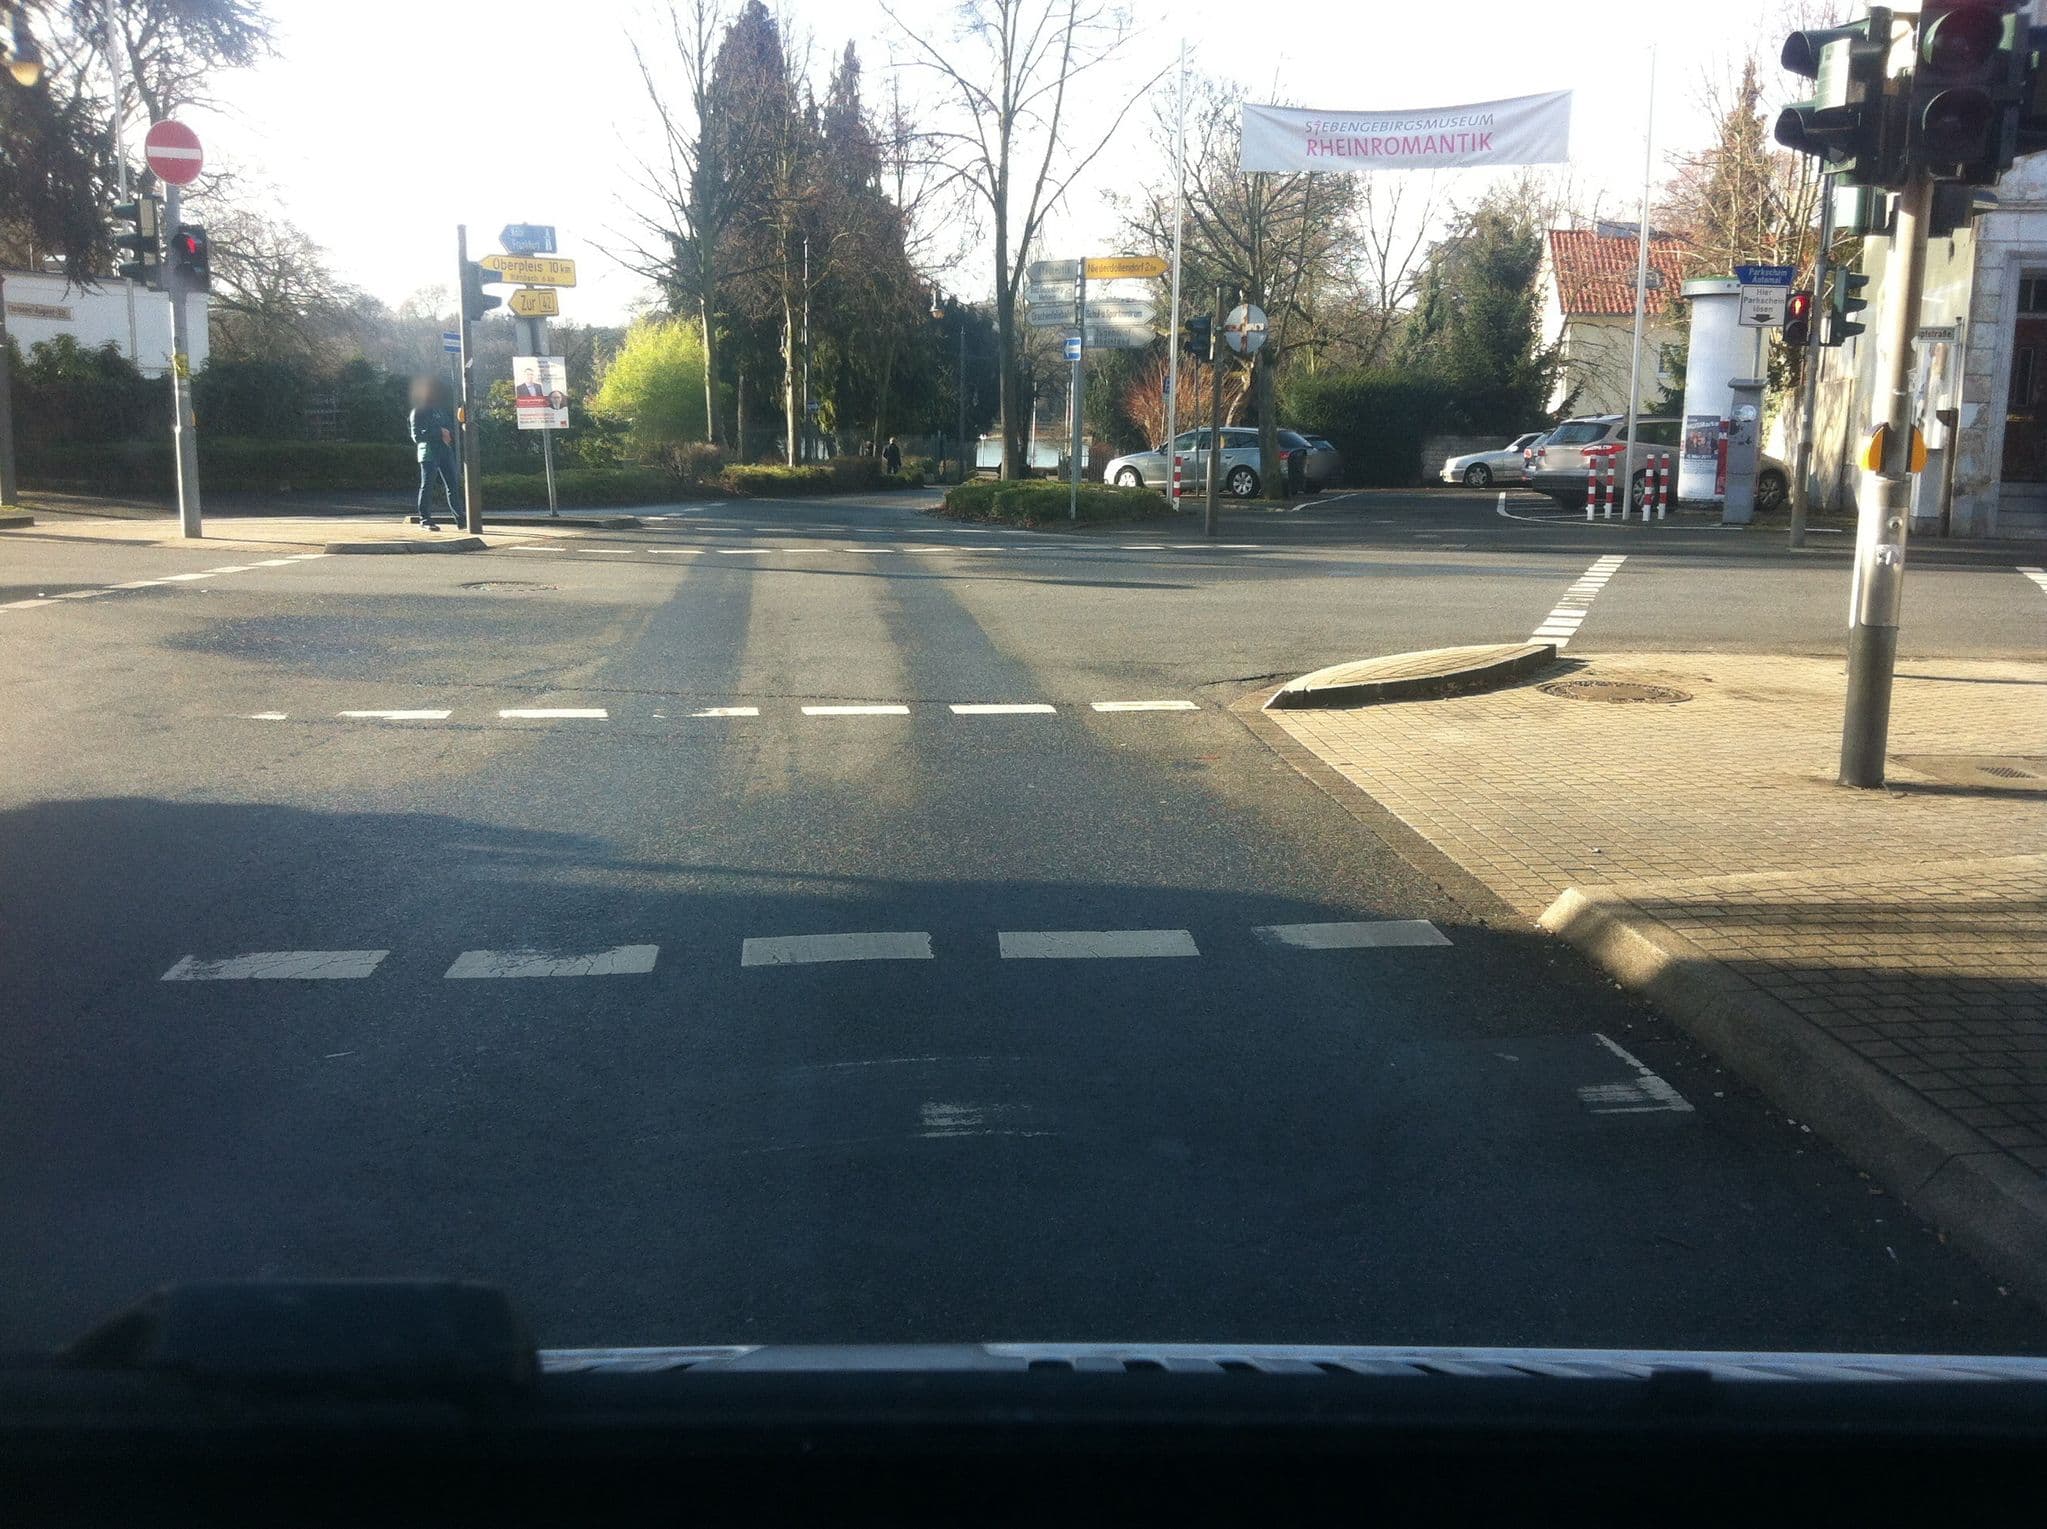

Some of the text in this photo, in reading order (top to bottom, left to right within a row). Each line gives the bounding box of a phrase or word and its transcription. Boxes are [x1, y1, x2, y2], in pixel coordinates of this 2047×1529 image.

[1306, 131, 1493, 157] RHEINROMANTIK
[492, 256, 572, 274] Oberpleis 10 km
[1756, 288, 1773, 296] Hier
[520, 294, 552, 311] Zur 42
[1743, 296, 1785, 304] Parkschein
[1753, 304, 1774, 313] lösen
